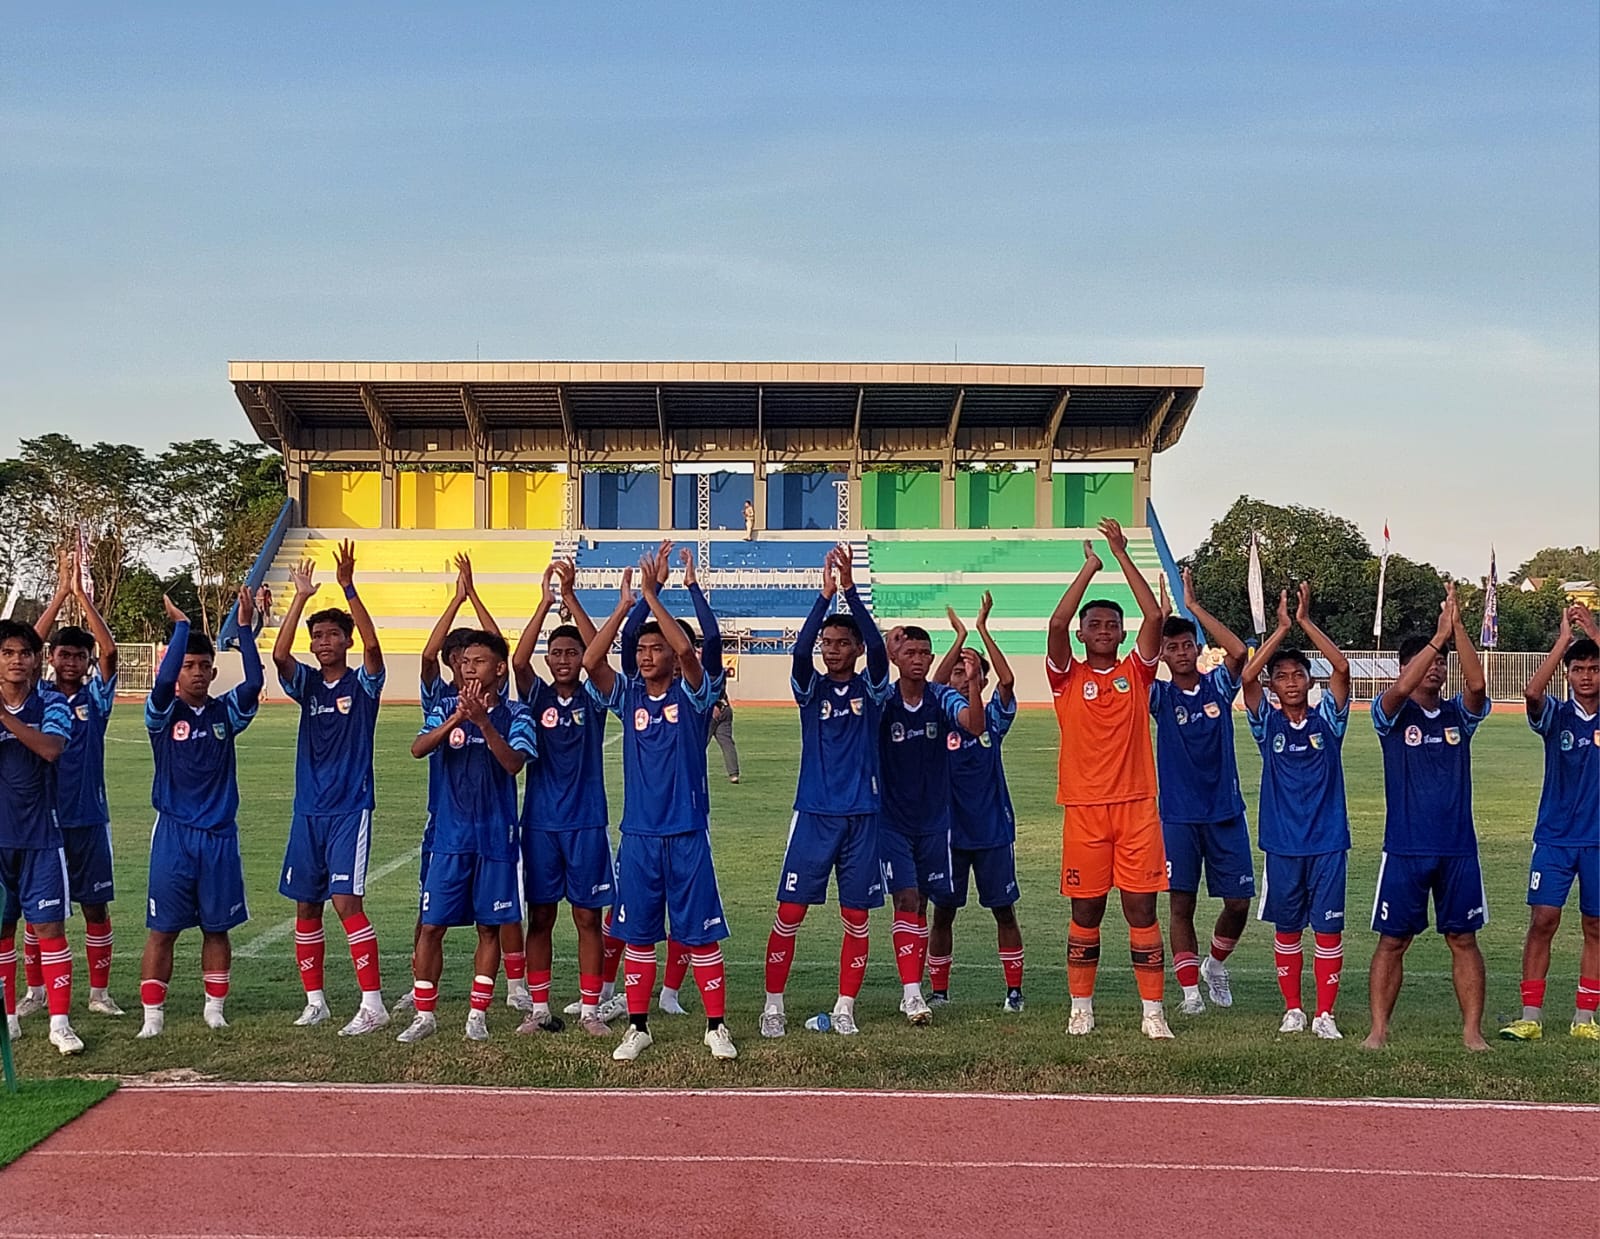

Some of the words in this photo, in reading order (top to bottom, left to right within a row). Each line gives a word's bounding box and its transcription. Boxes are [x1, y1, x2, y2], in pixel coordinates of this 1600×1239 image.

[785, 872, 798, 891] 12
[1066, 868, 1081, 887] 25
[1530, 871, 1541, 890] 18
[422, 892, 430, 911] 2
[1381, 901, 1389, 920] 5
